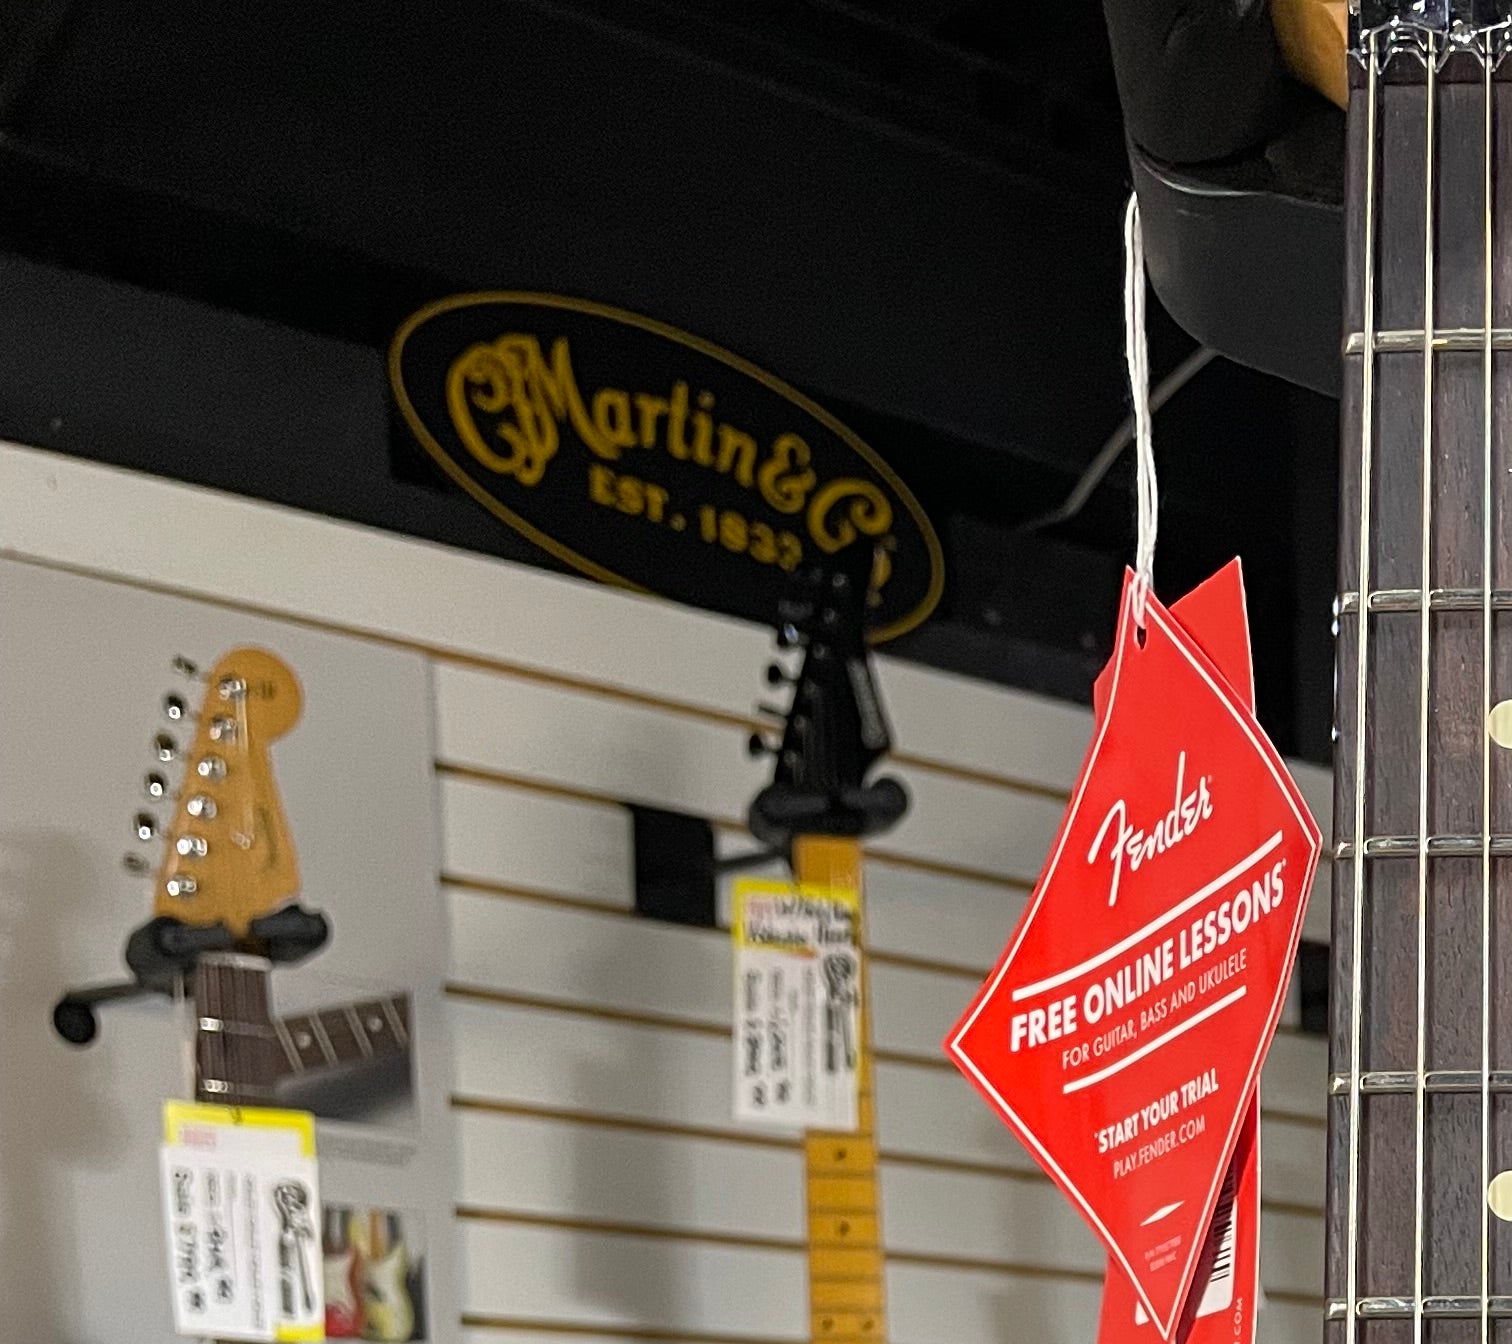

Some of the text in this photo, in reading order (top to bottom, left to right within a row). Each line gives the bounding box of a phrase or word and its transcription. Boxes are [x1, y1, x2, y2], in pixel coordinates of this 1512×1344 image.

[589, 464, 686, 532] EST.
[1088, 751, 1214, 906] Fender
[1010, 995, 1078, 1053] FREE
[1083, 936, 1175, 1024] ONLINE
[1062, 1043, 1090, 1070] FOR
[1140, 1002, 1168, 1033] BASS
[1170, 982, 1197, 1013] AND
[1198, 947, 1247, 996] UKULELE
[1140, 1090, 1179, 1131] YOUR
[1180, 1067, 1219, 1109] TRIAL
[1113, 1114, 1206, 1180] PLAY.FENDER.COM
